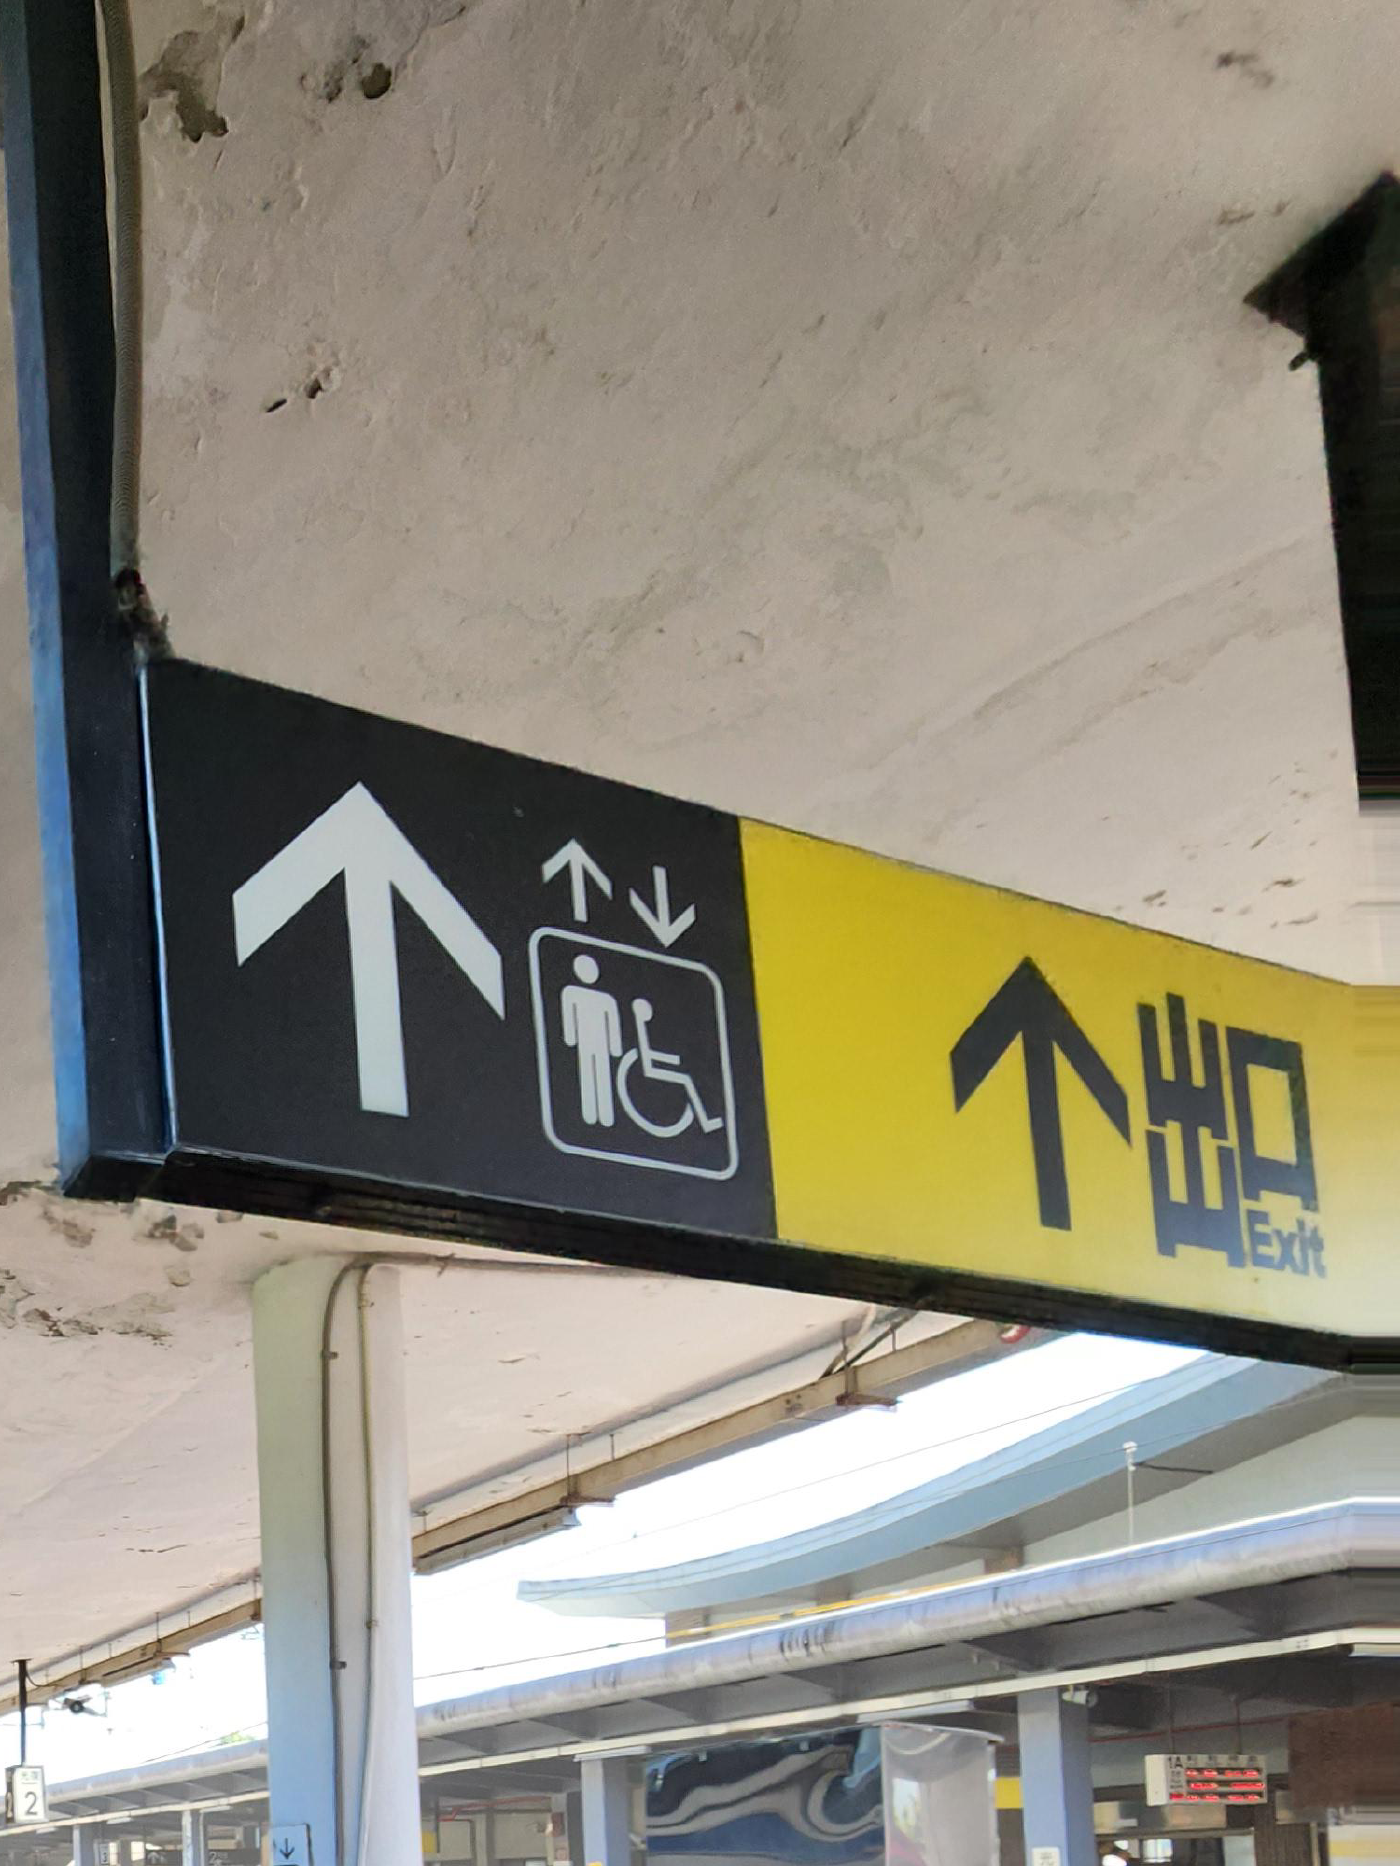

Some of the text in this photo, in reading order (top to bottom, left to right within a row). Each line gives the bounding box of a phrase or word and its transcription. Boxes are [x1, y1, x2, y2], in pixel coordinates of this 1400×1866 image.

[1137, 992, 1319, 1267] 出口
[1246, 1208, 1327, 1278] Exit
[24, 1791, 38, 1816] 2
